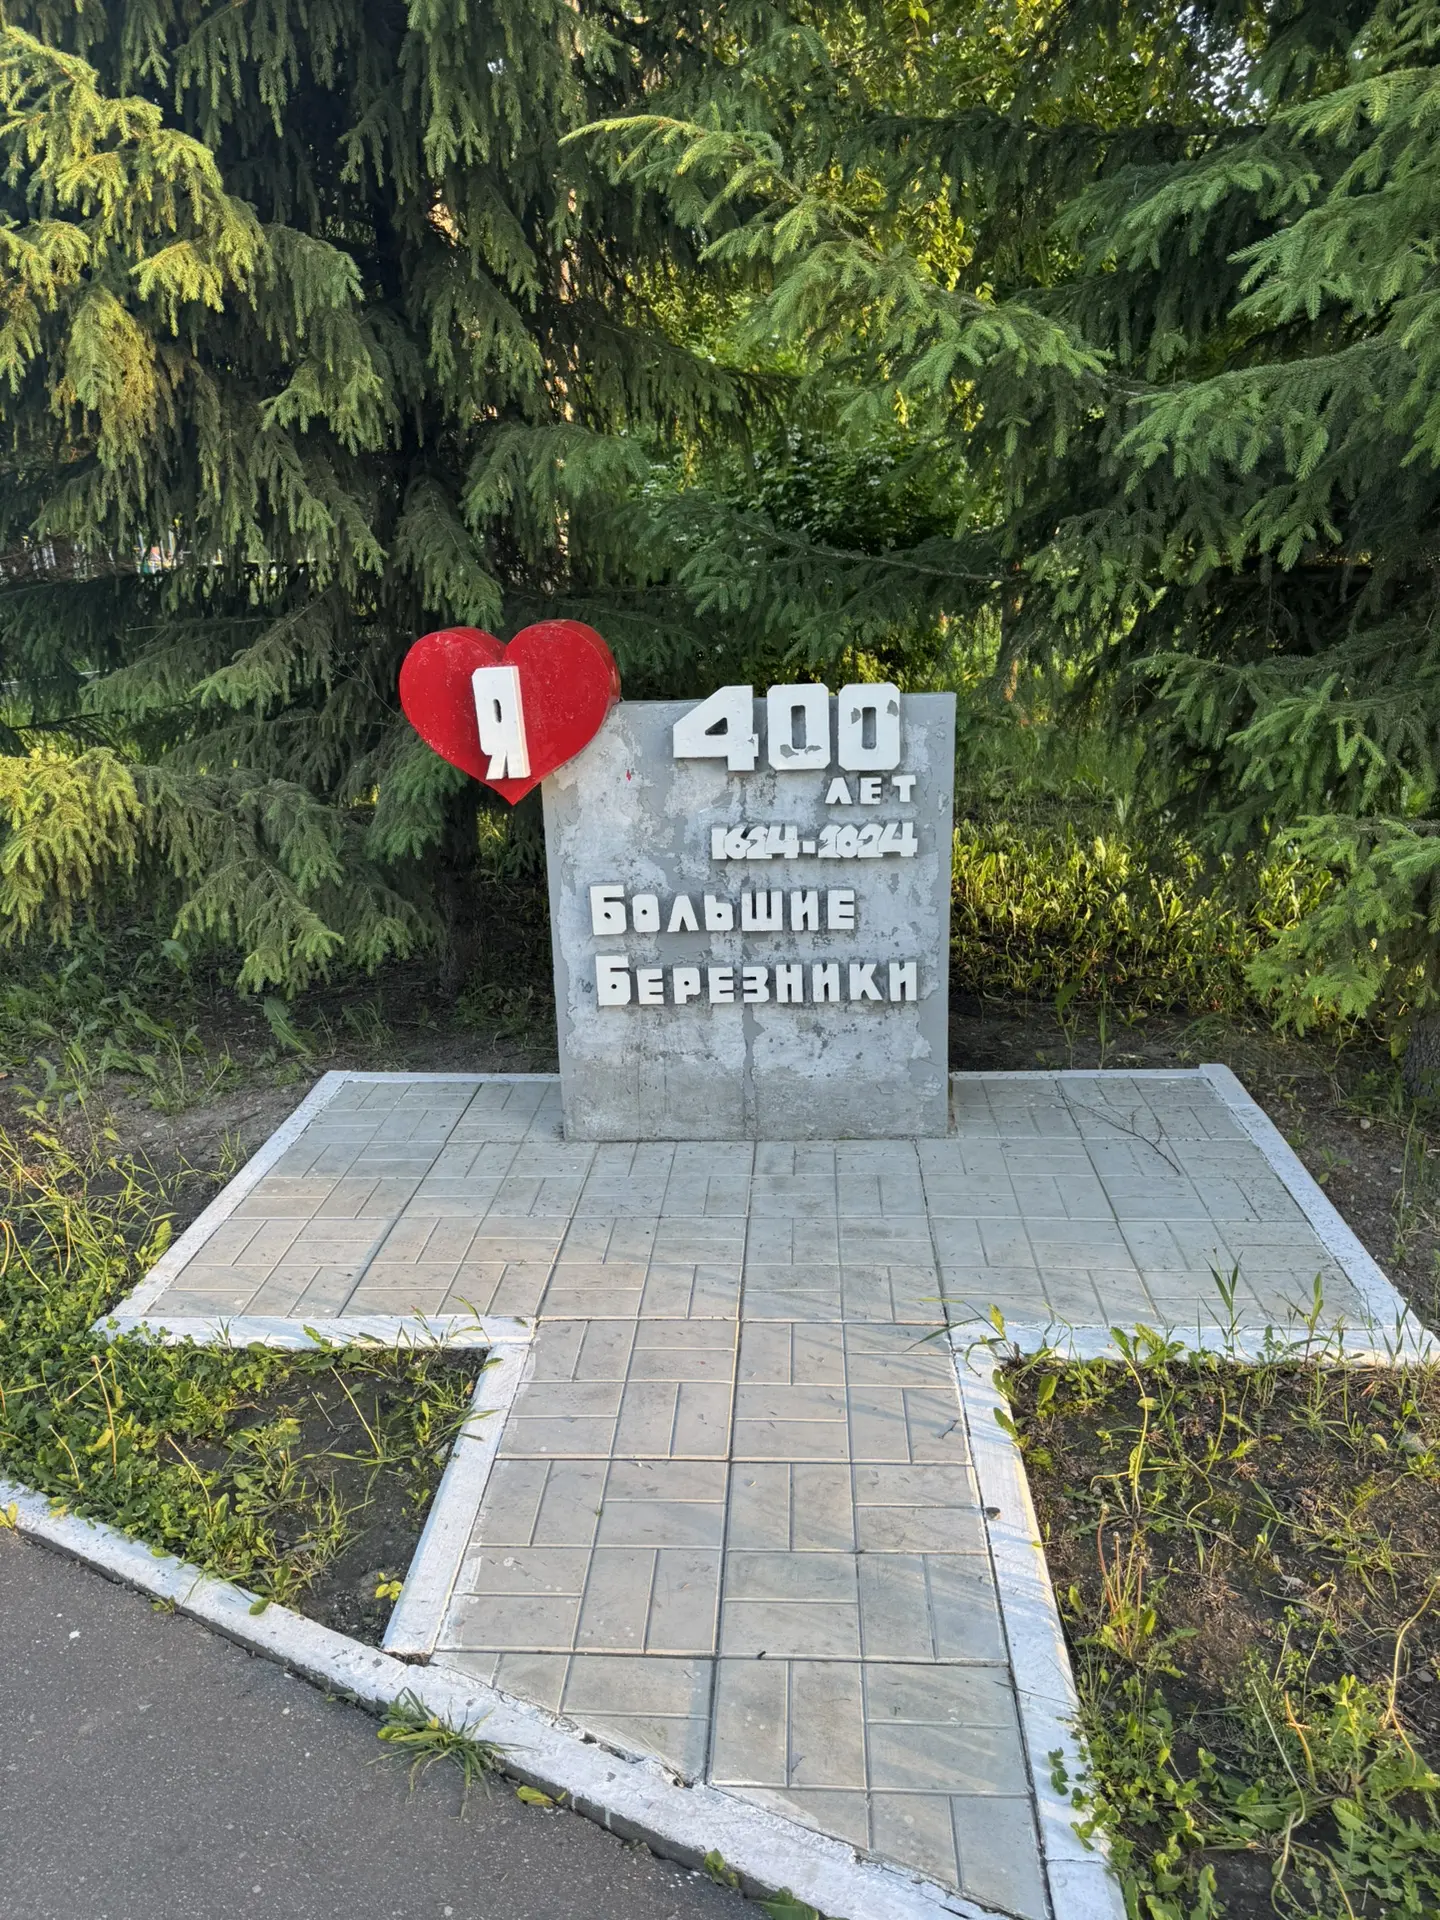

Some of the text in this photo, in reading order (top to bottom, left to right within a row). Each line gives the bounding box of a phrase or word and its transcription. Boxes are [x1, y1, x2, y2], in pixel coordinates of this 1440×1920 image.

[471, 665, 532, 780] Я
[672, 682, 902, 771] 400
[825, 774, 917, 805] ЛЕТ
[711, 822, 918, 860] 1624-2024
[589, 884, 857, 936] БОЛЬШИЕ
[595, 954, 918, 1006] БЕРЕЗНИКИ
